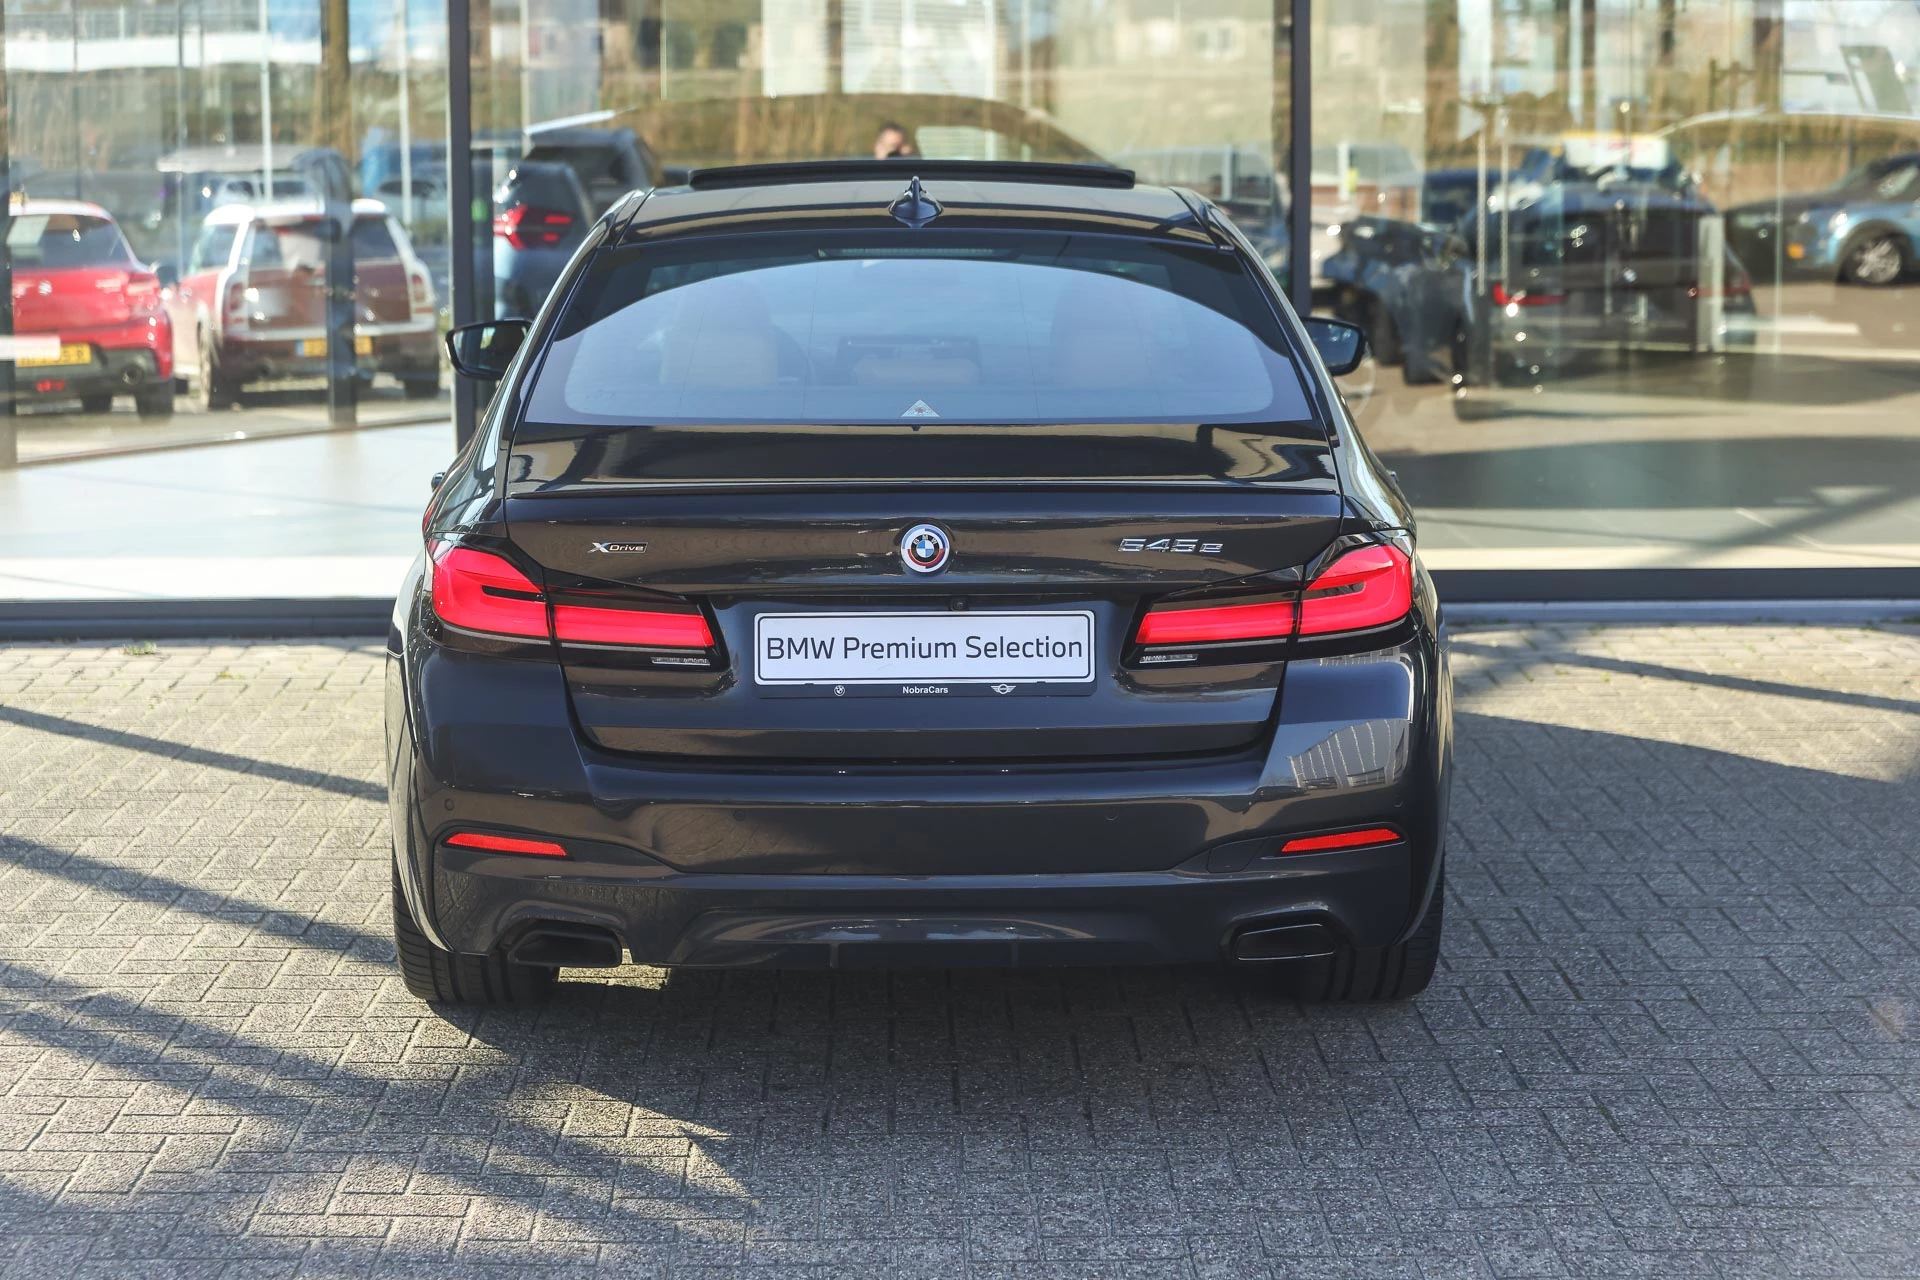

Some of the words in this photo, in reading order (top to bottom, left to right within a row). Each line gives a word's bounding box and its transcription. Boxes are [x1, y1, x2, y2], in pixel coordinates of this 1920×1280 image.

[766, 637, 836, 660] BMW
[843, 636, 957, 660] Premium
[965, 635, 1083, 659] Selection
[902, 685, 949, 694] NobraCars
